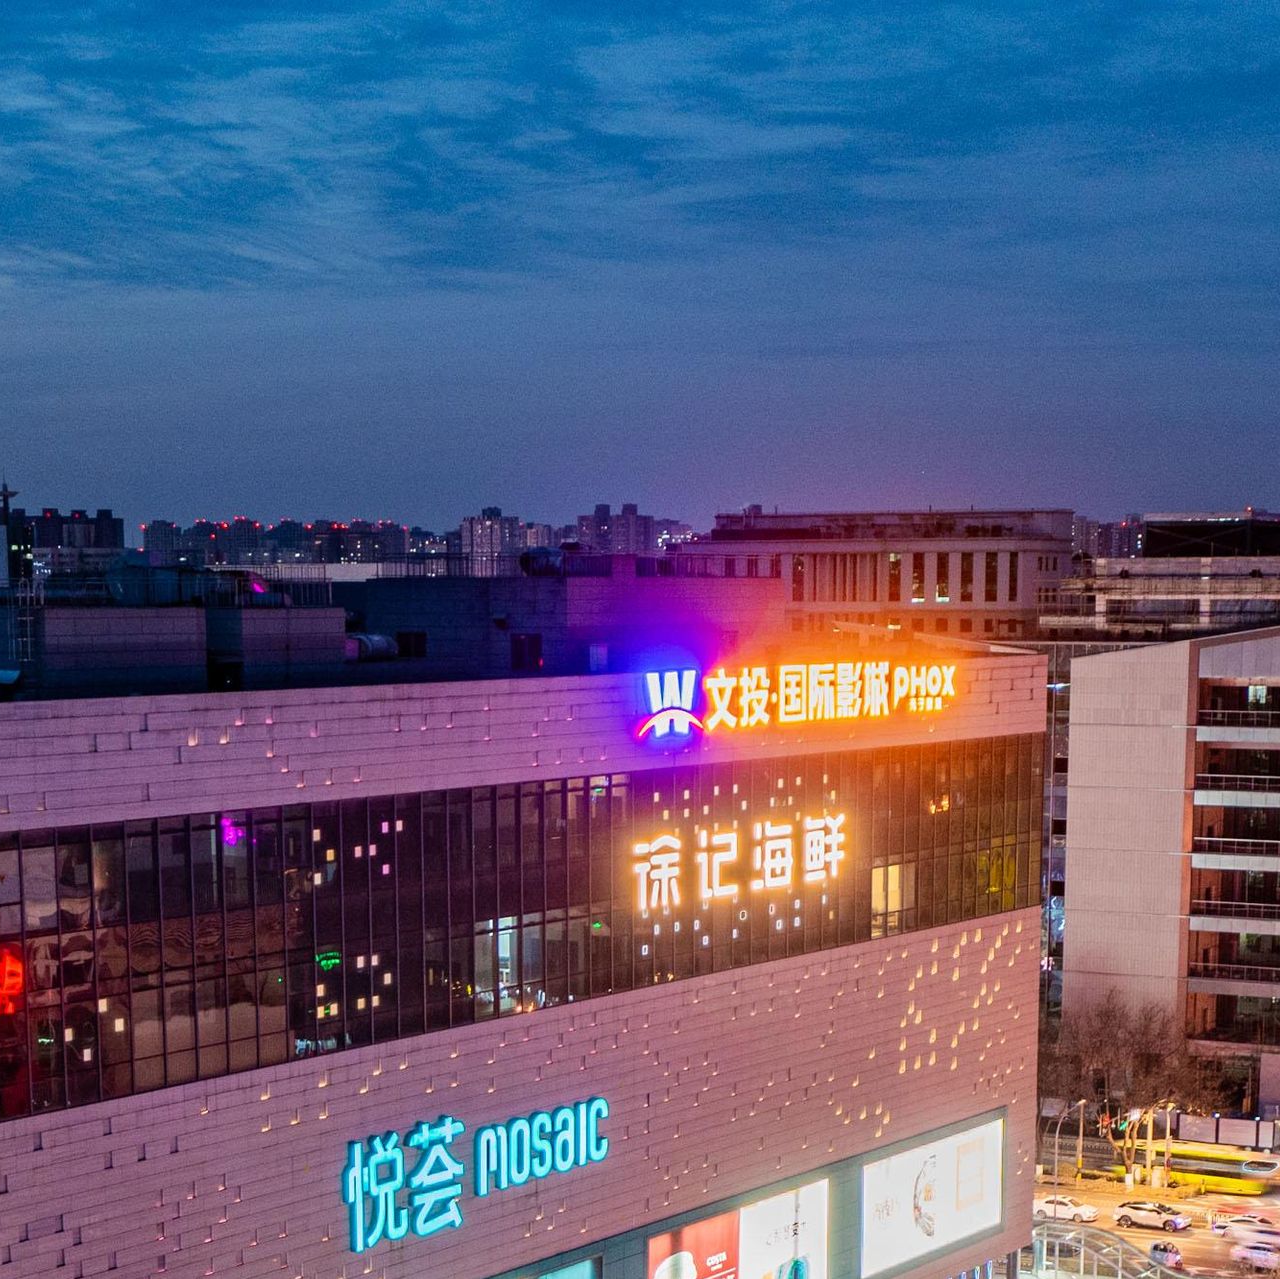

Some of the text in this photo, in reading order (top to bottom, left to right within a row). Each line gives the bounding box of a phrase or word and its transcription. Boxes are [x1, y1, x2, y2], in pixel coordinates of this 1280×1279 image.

[634, 812, 846, 911] 徐记海鲜
[342, 1114, 466, 1253] 悦荟
